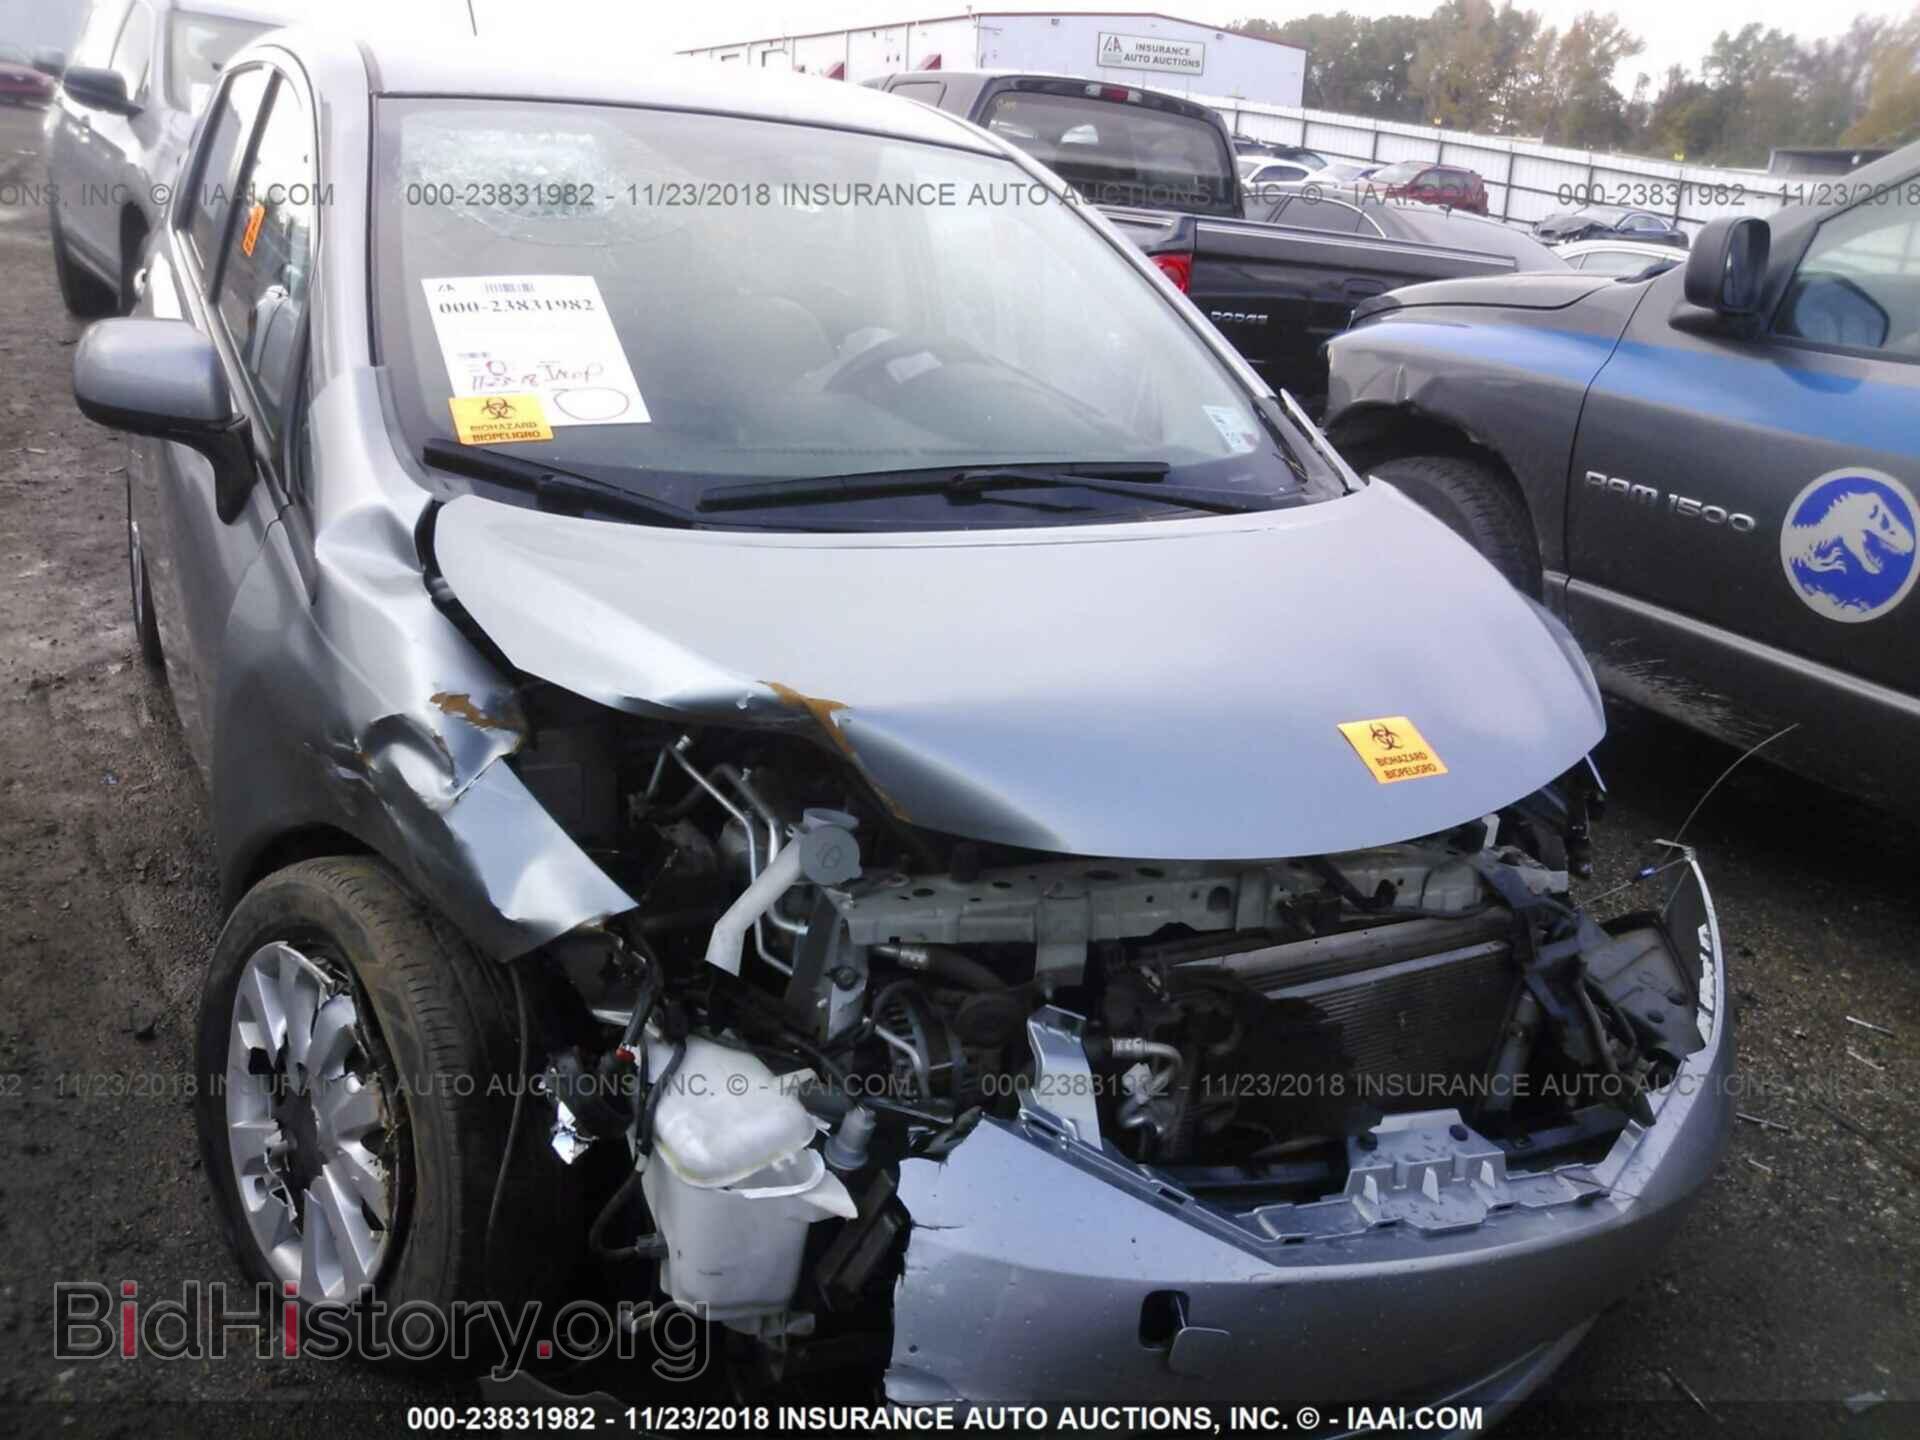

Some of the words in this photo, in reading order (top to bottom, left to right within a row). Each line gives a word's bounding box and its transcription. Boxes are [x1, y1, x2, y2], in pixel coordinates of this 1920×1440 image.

[1135, 43, 1190, 56] INSURANCE
[1124, 53, 1151, 63] AUTO
[1152, 55, 1201, 68] AUCTIONS
[438, 299, 595, 314] 000-23831982
[469, 421, 538, 432] BIOHAZARD
[472, 430, 541, 442] BIOPELIGRO
[1669, 493, 1756, 532] 1500
[1375, 751, 1428, 766] BIOHAZARD
[1383, 763, 1437, 779] BIOPELIGRO
